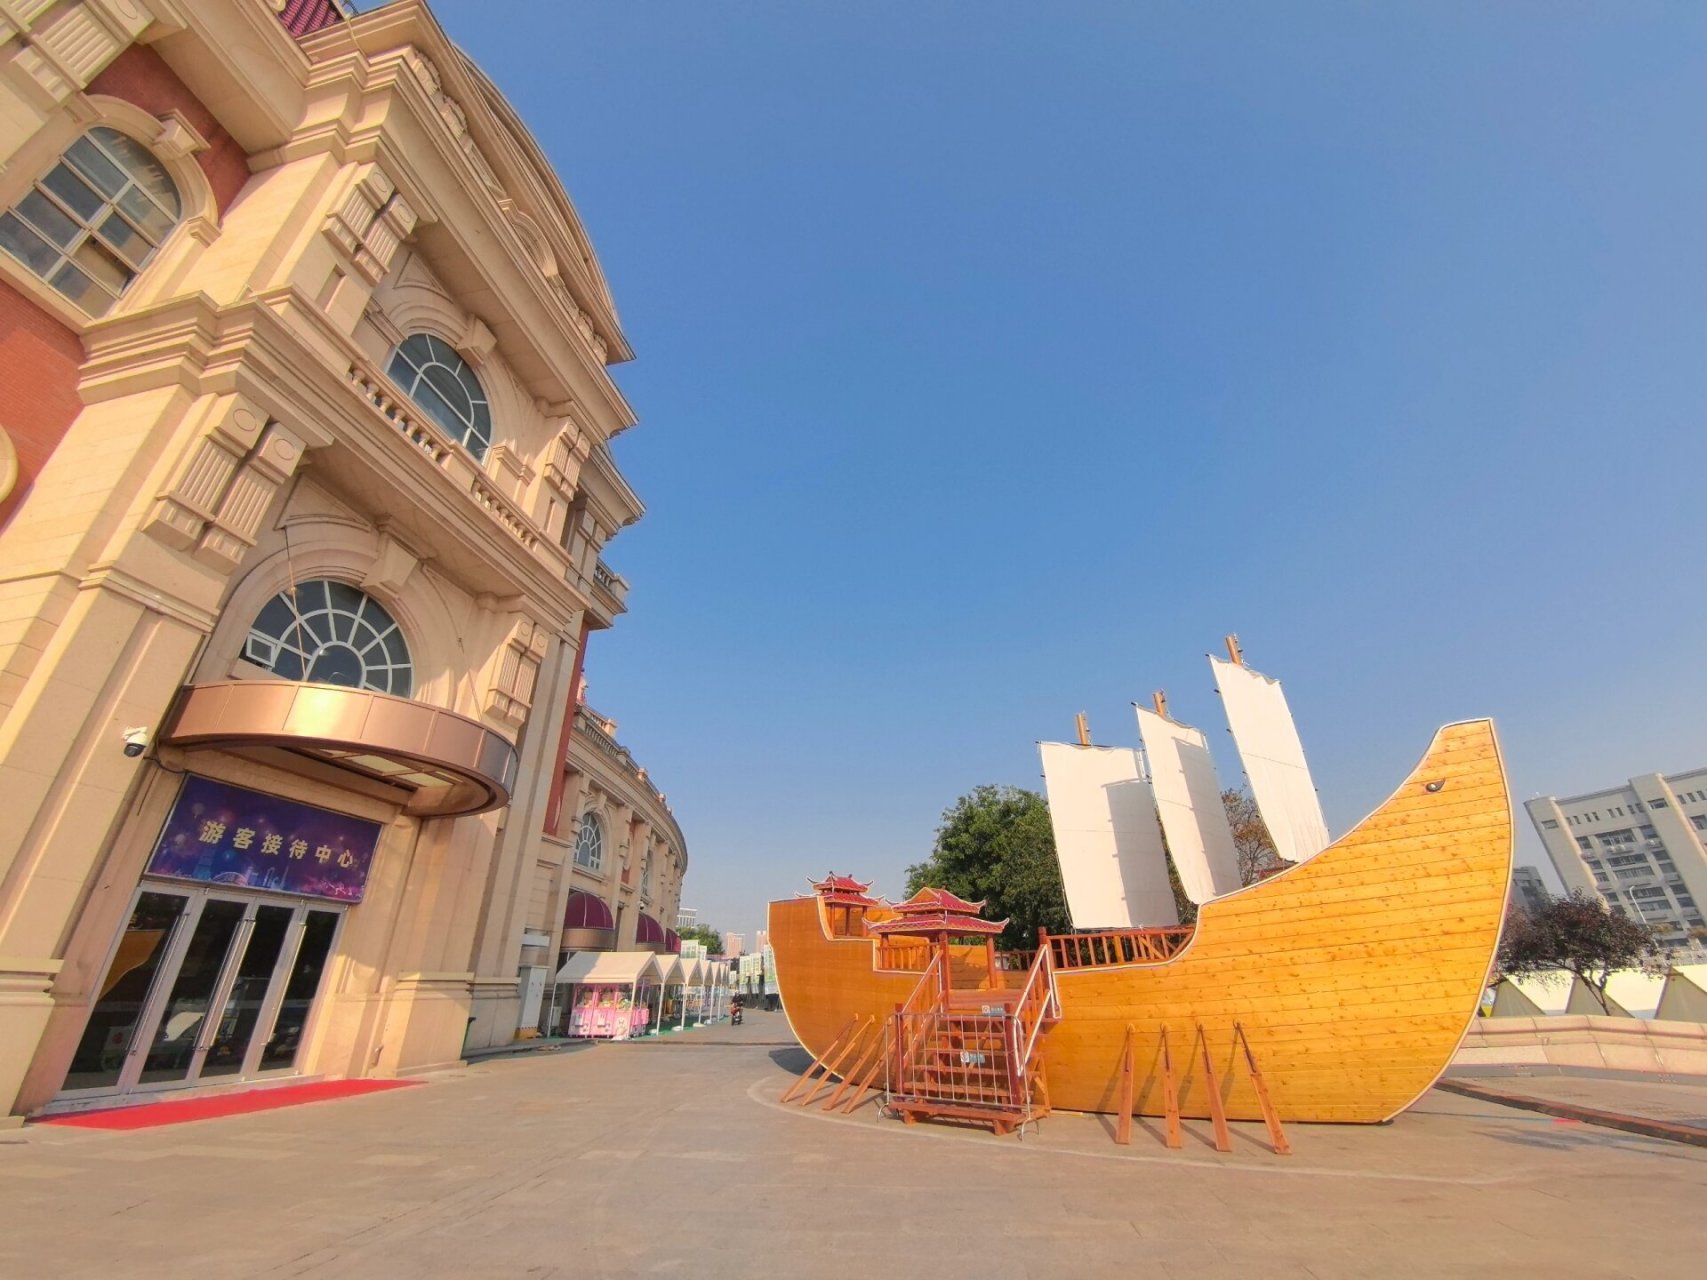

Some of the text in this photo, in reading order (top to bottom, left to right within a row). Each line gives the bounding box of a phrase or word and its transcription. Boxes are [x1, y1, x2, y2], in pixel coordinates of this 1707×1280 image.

[199, 820, 353, 868] 游客接待中心
